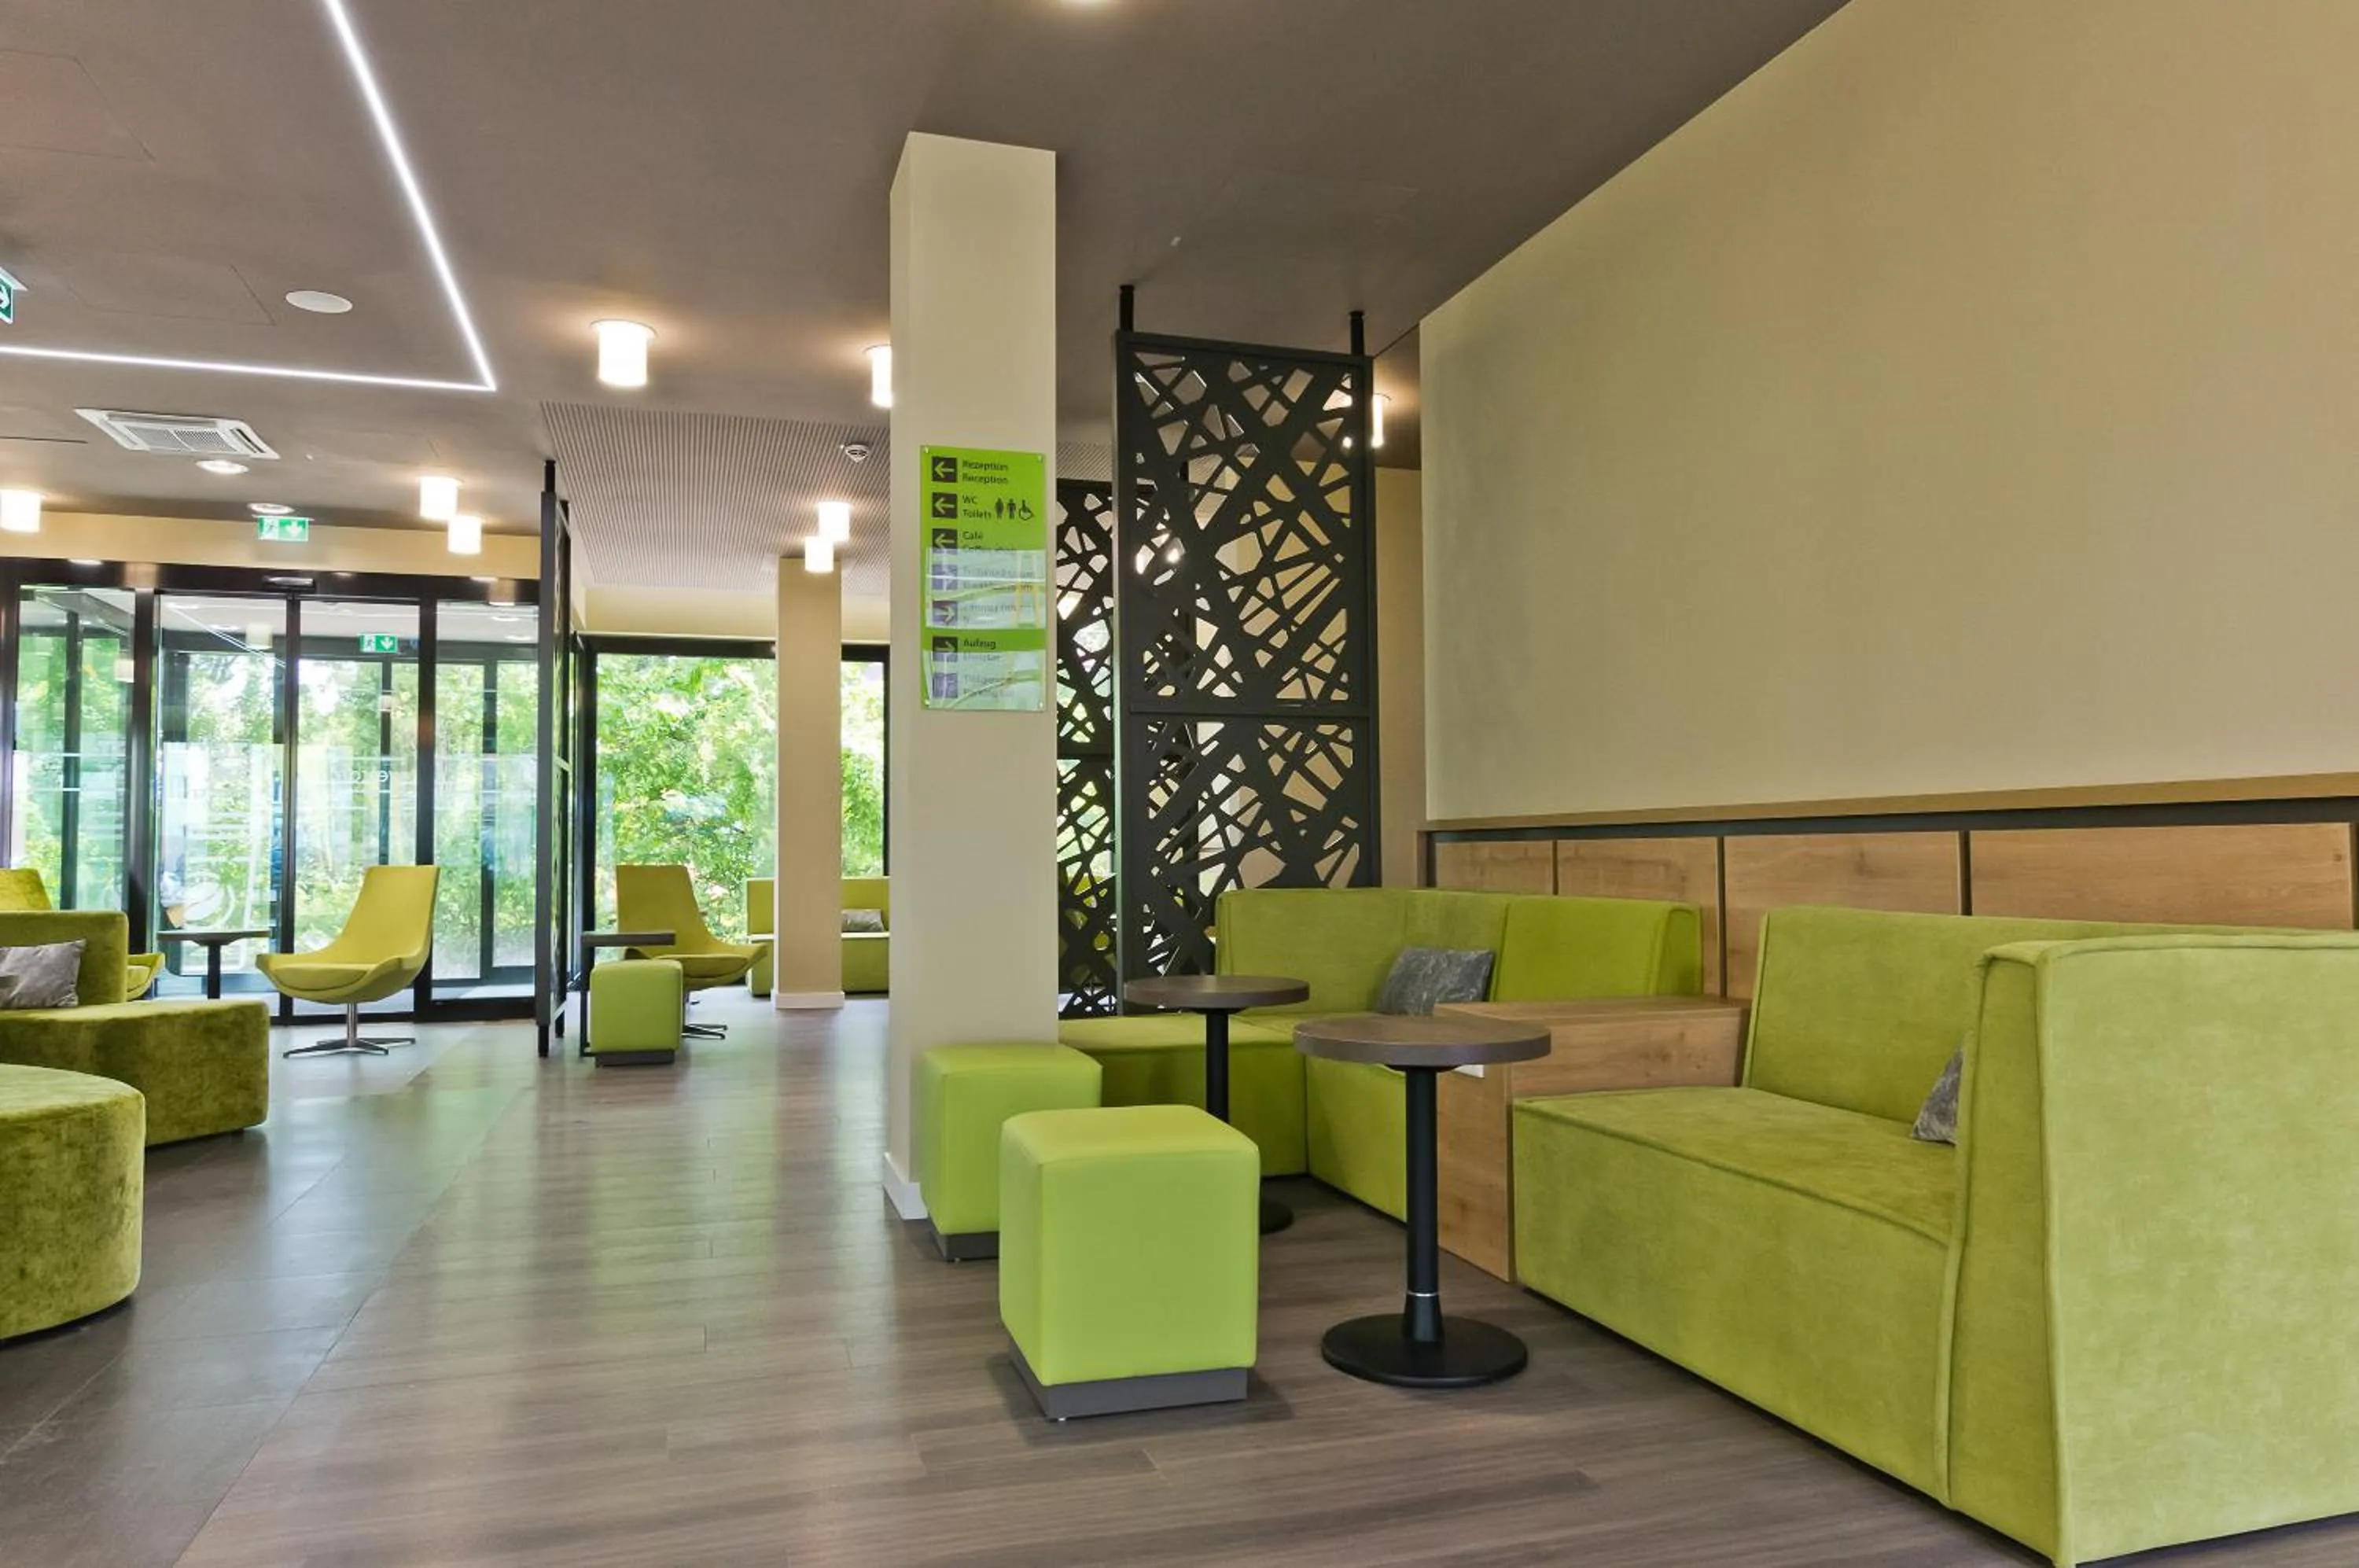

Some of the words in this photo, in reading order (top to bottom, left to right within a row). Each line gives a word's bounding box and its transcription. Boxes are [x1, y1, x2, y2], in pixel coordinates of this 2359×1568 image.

[962, 473, 1009, 484] Reception
[962, 495, 978, 505] WC
[962, 509, 992, 519] Toilets
[963, 638, 996, 650] Aufzug
